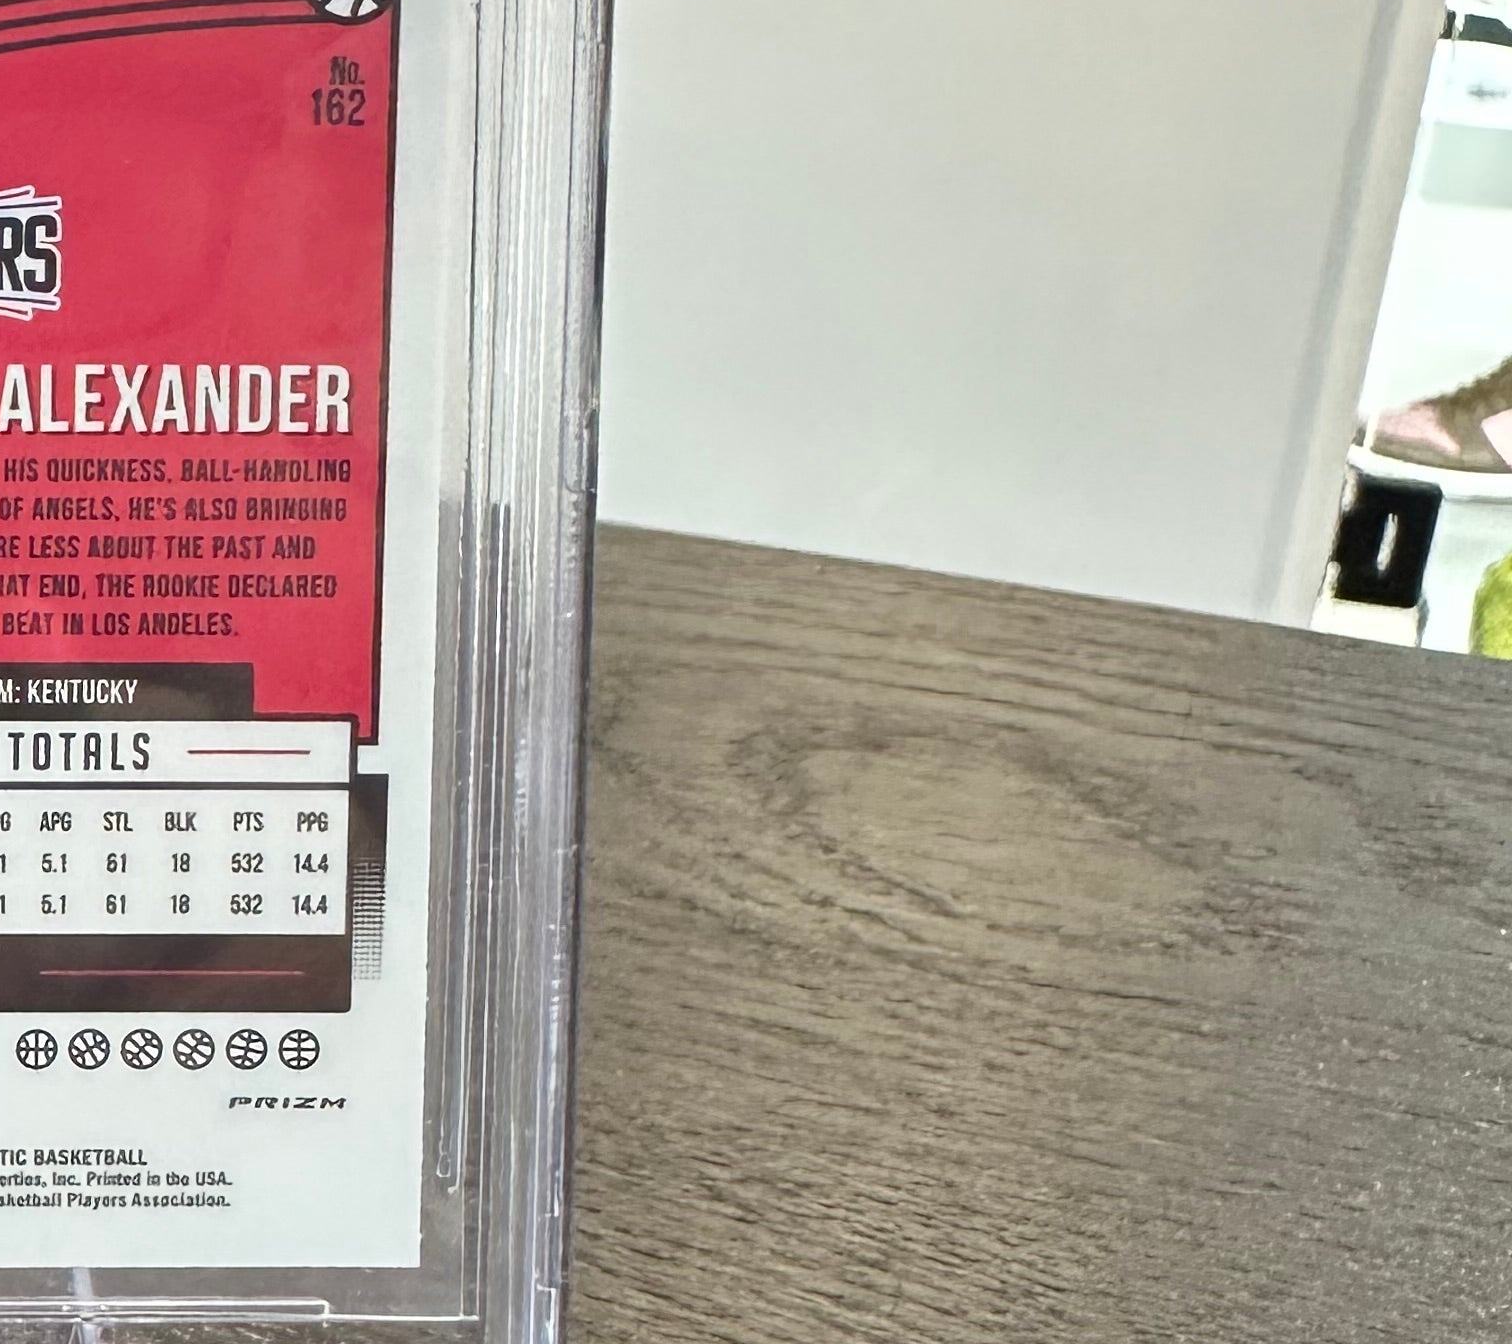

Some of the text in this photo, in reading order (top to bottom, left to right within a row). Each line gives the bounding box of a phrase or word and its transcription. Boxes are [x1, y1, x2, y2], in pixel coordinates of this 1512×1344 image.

[328, 55, 366, 86] No.
[310, 86, 368, 128] 162
[4, 457, 39, 483] HIS
[128, 496, 177, 521] HE'S
[184, 497, 238, 522] ALSO
[245, 497, 347, 522] BRINGING
[28, 534, 81, 559] LESS
[87, 535, 156, 560] ABOUT
[163, 535, 205, 560] THE
[212, 535, 266, 560] PAST
[271, 534, 316, 560] AND
[39, 574, 86, 600] END,
[95, 573, 136, 599] THE
[142, 574, 220, 598] ROOKIE
[228, 574, 338, 598] DECLARED
[2, 611, 54, 636] BEAT
[62, 612, 84, 636] IN
[91, 612, 131, 636] LOS
[27, 678, 138, 704] KENTUCKY
[6, 730, 152, 773] TOTALS
[39, 811, 72, 832] APG
[102, 810, 134, 832] STL
[164, 811, 197, 832] BLK
[233, 811, 265, 832] PTS
[296, 811, 329, 833] PPG
[106, 852, 127, 874] 61
[171, 852, 191, 873] 18
[231, 852, 264, 874] 532
[293, 853, 329, 874] 14.4
[106, 893, 126, 915] 61
[170, 893, 190, 915] 18
[230, 893, 263, 915] 532
[291, 894, 328, 916] 14.4
[228, 1096, 347, 1110] PRIZM
[33, 1148, 148, 1166] BASKETBALL
